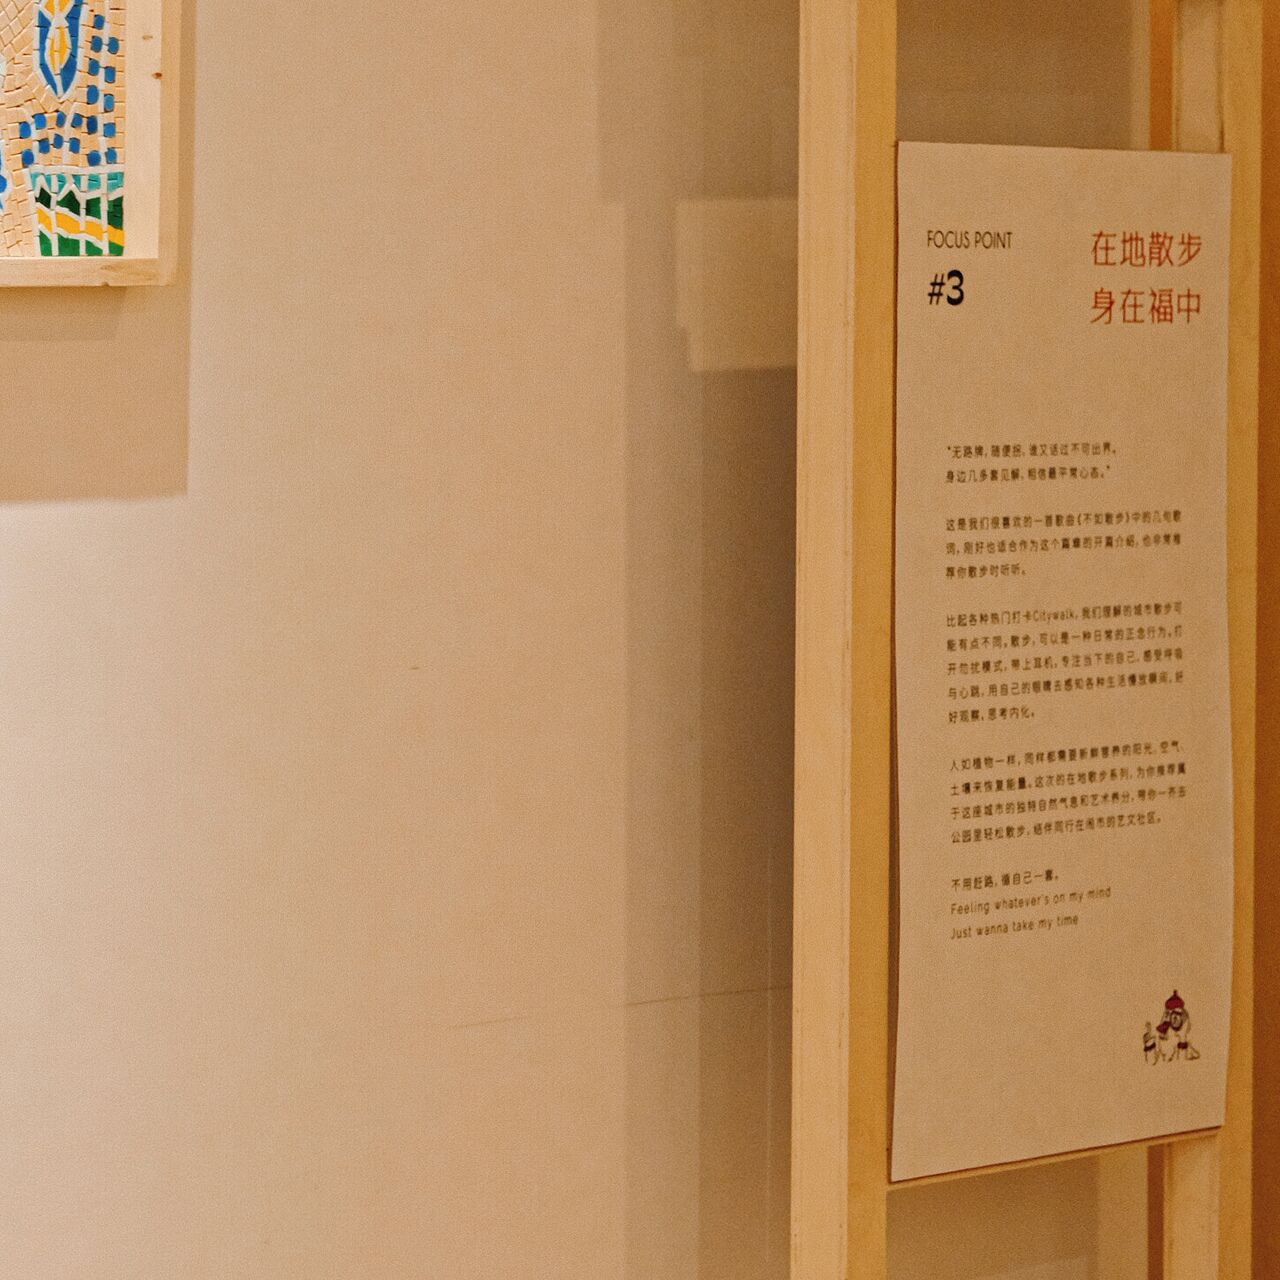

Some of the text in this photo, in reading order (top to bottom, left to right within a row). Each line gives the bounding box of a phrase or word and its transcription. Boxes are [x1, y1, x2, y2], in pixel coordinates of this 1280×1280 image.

[927, 230, 1013, 249] FOCUS POINT
[1091, 231, 1202, 267] 在地散步
[927, 269, 965, 306] #3
[1091, 287, 1201, 324] 身在福中
[951, 902, 990, 915] Feeling
[1053, 894, 1065, 904] on
[1070, 891, 1084, 903] my
[1087, 886, 1111, 899] mind
[951, 915, 1078, 940] Just wanna take my time
